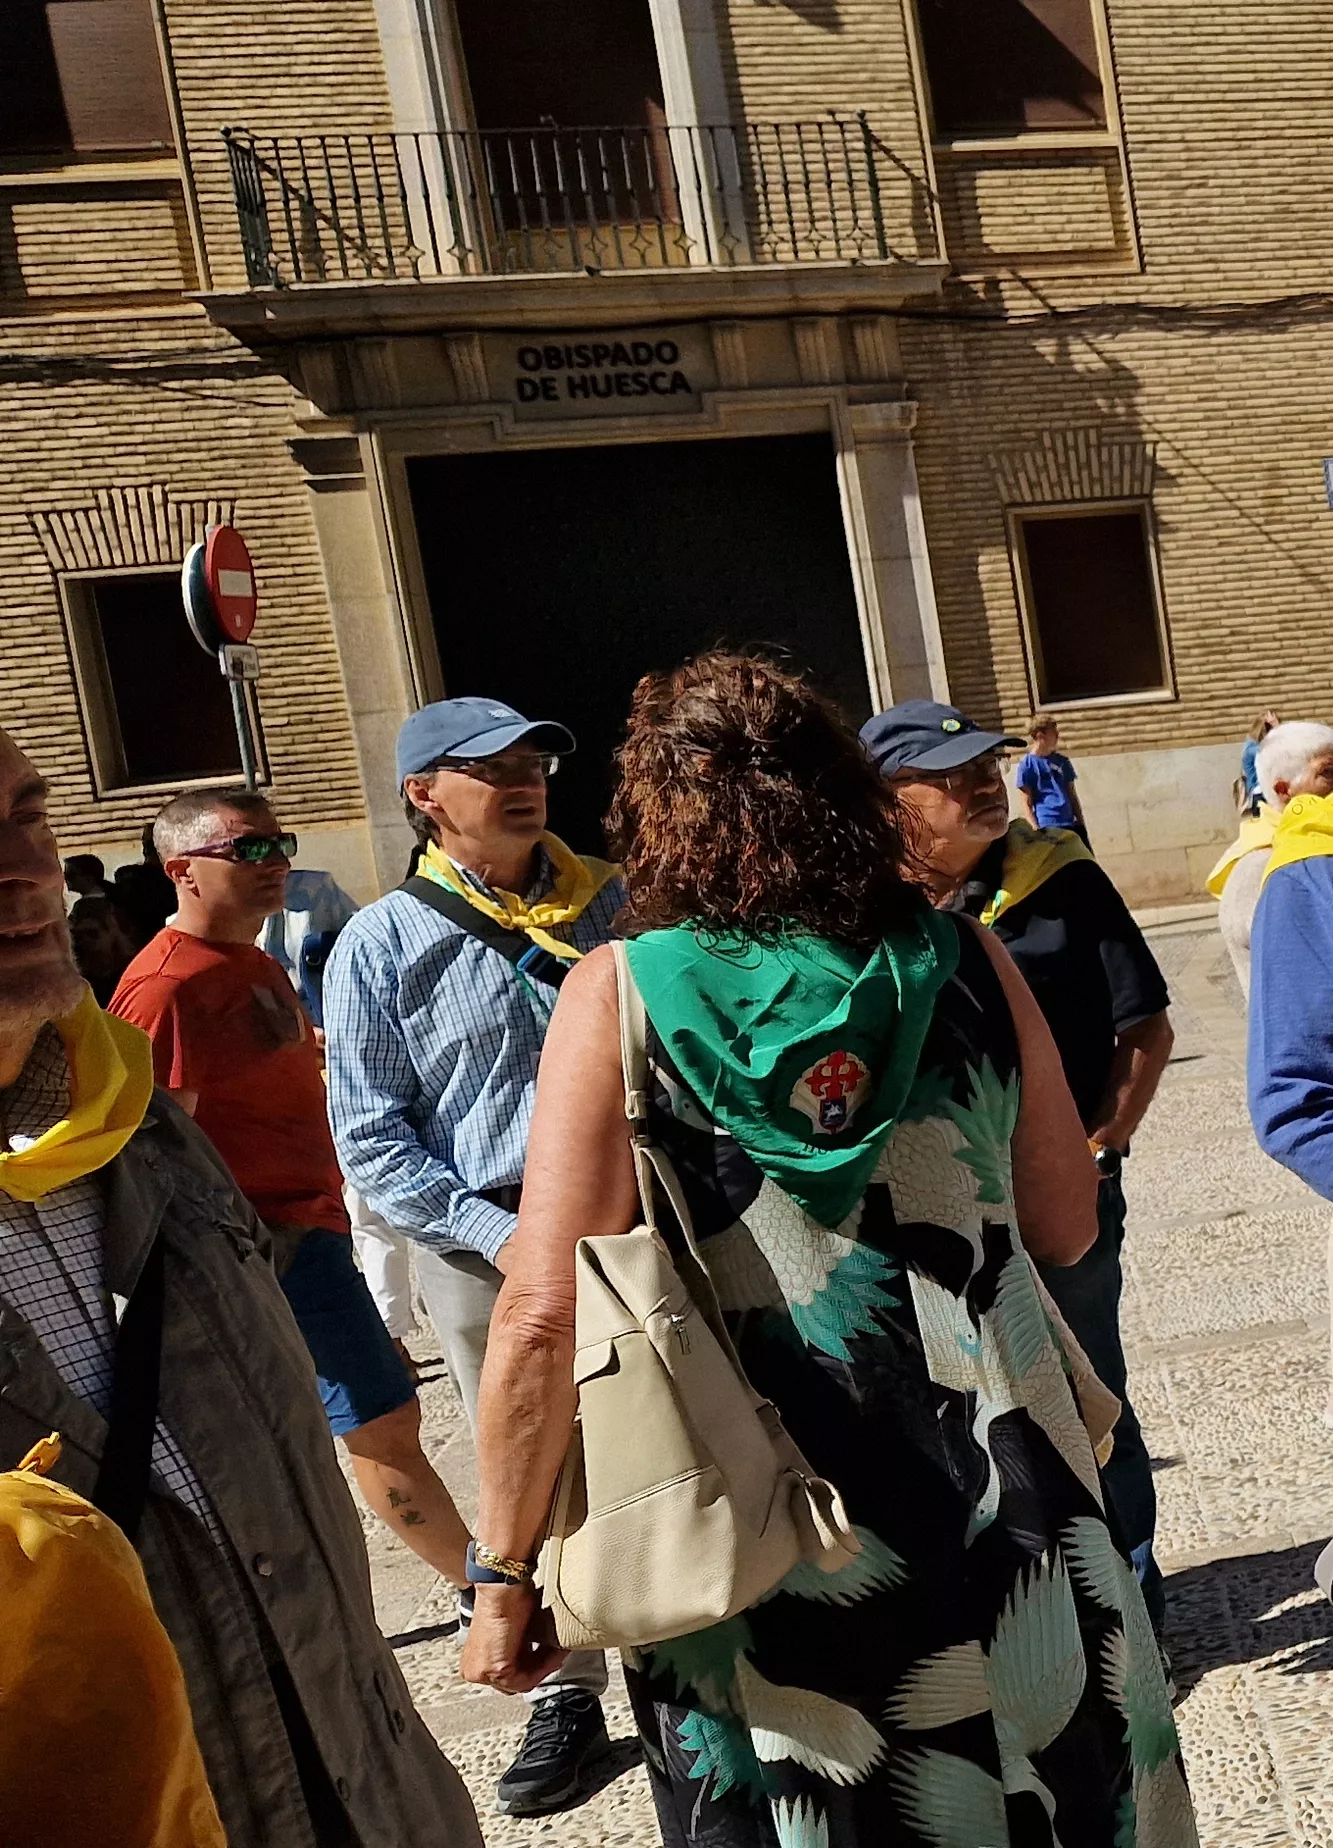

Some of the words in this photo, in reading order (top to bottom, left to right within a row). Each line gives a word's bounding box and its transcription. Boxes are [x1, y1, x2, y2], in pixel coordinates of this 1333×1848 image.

[517, 339, 679, 371] OBISPADO
[516, 376, 560, 402] DE
[567, 370, 692, 399] HUESCA
